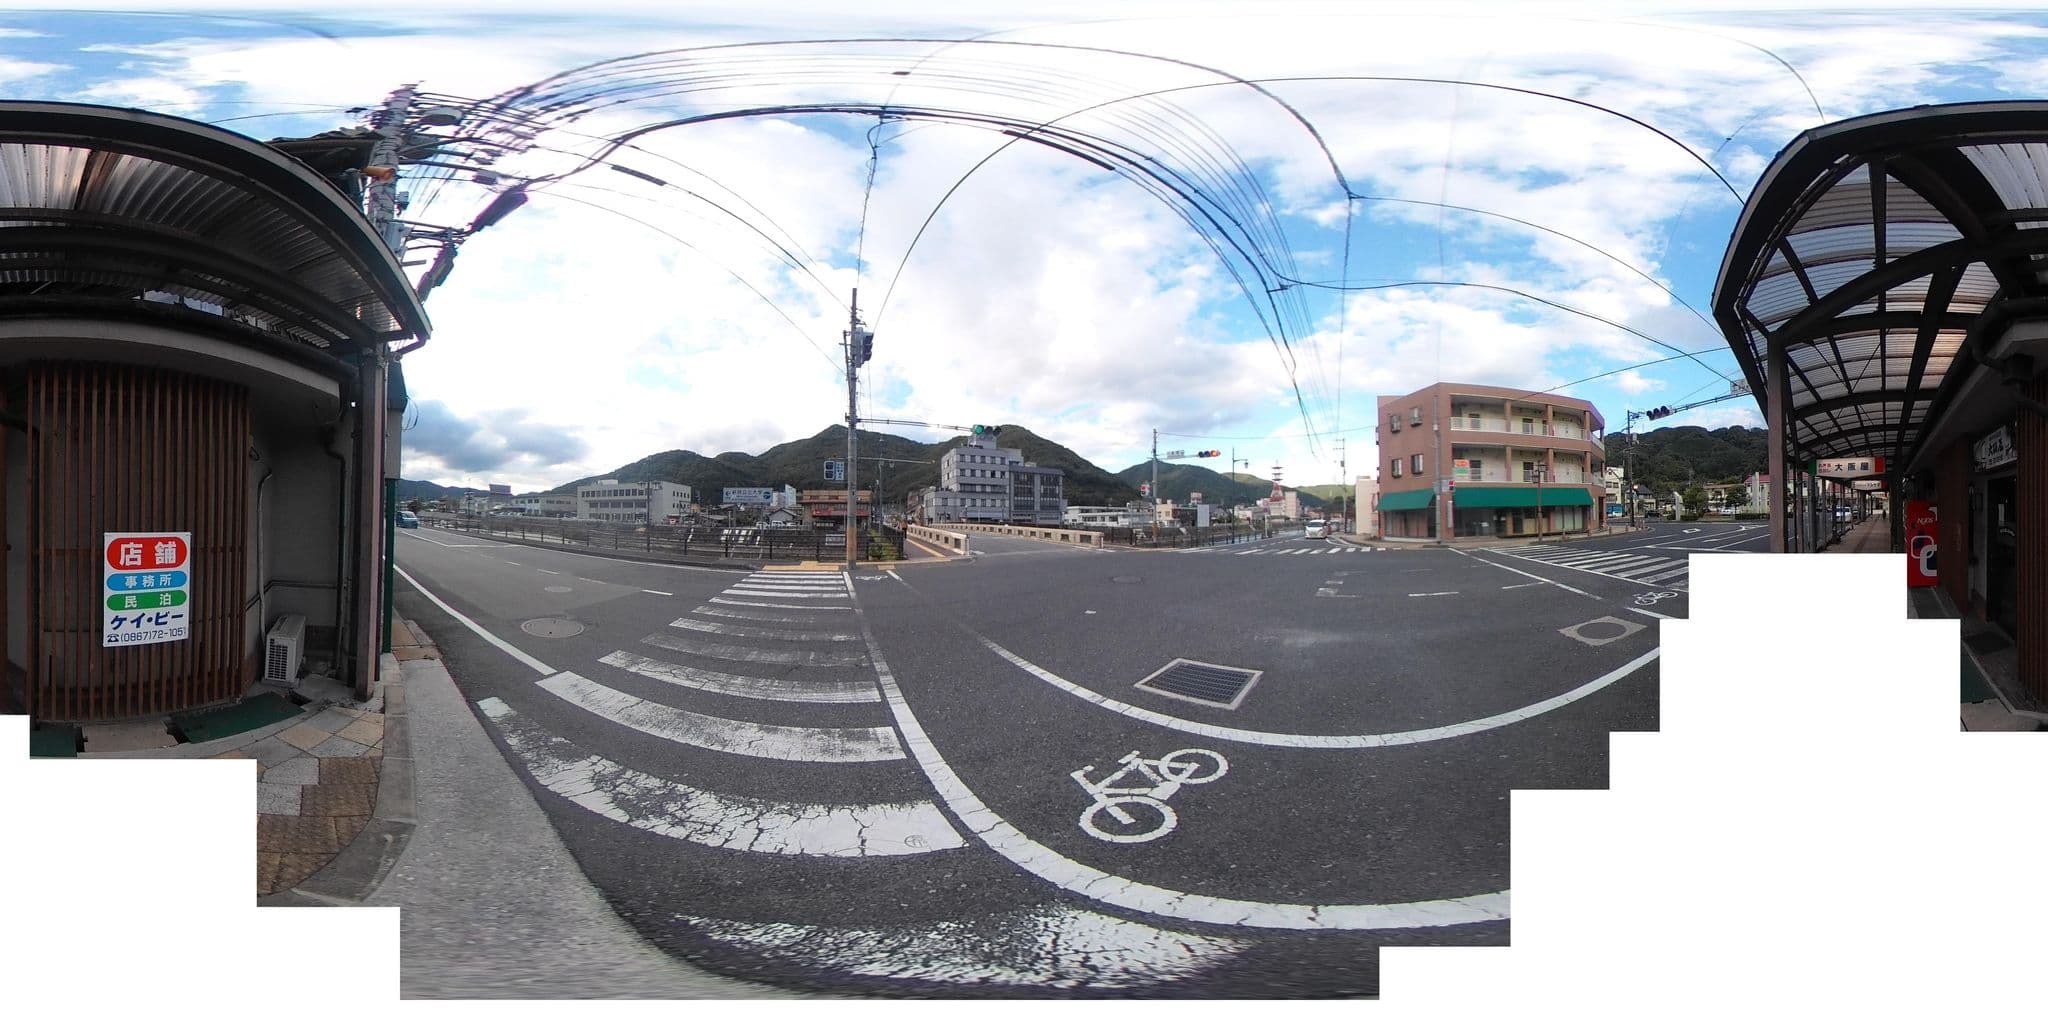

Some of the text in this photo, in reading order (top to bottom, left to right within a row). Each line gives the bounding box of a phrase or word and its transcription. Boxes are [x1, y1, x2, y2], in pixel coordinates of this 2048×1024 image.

[120, 541, 177, 566] 店舗
[124, 573, 172, 588] 事務所
[124, 592, 172, 608] 民泊
[110, 611, 184, 630] ケイ・ビー
